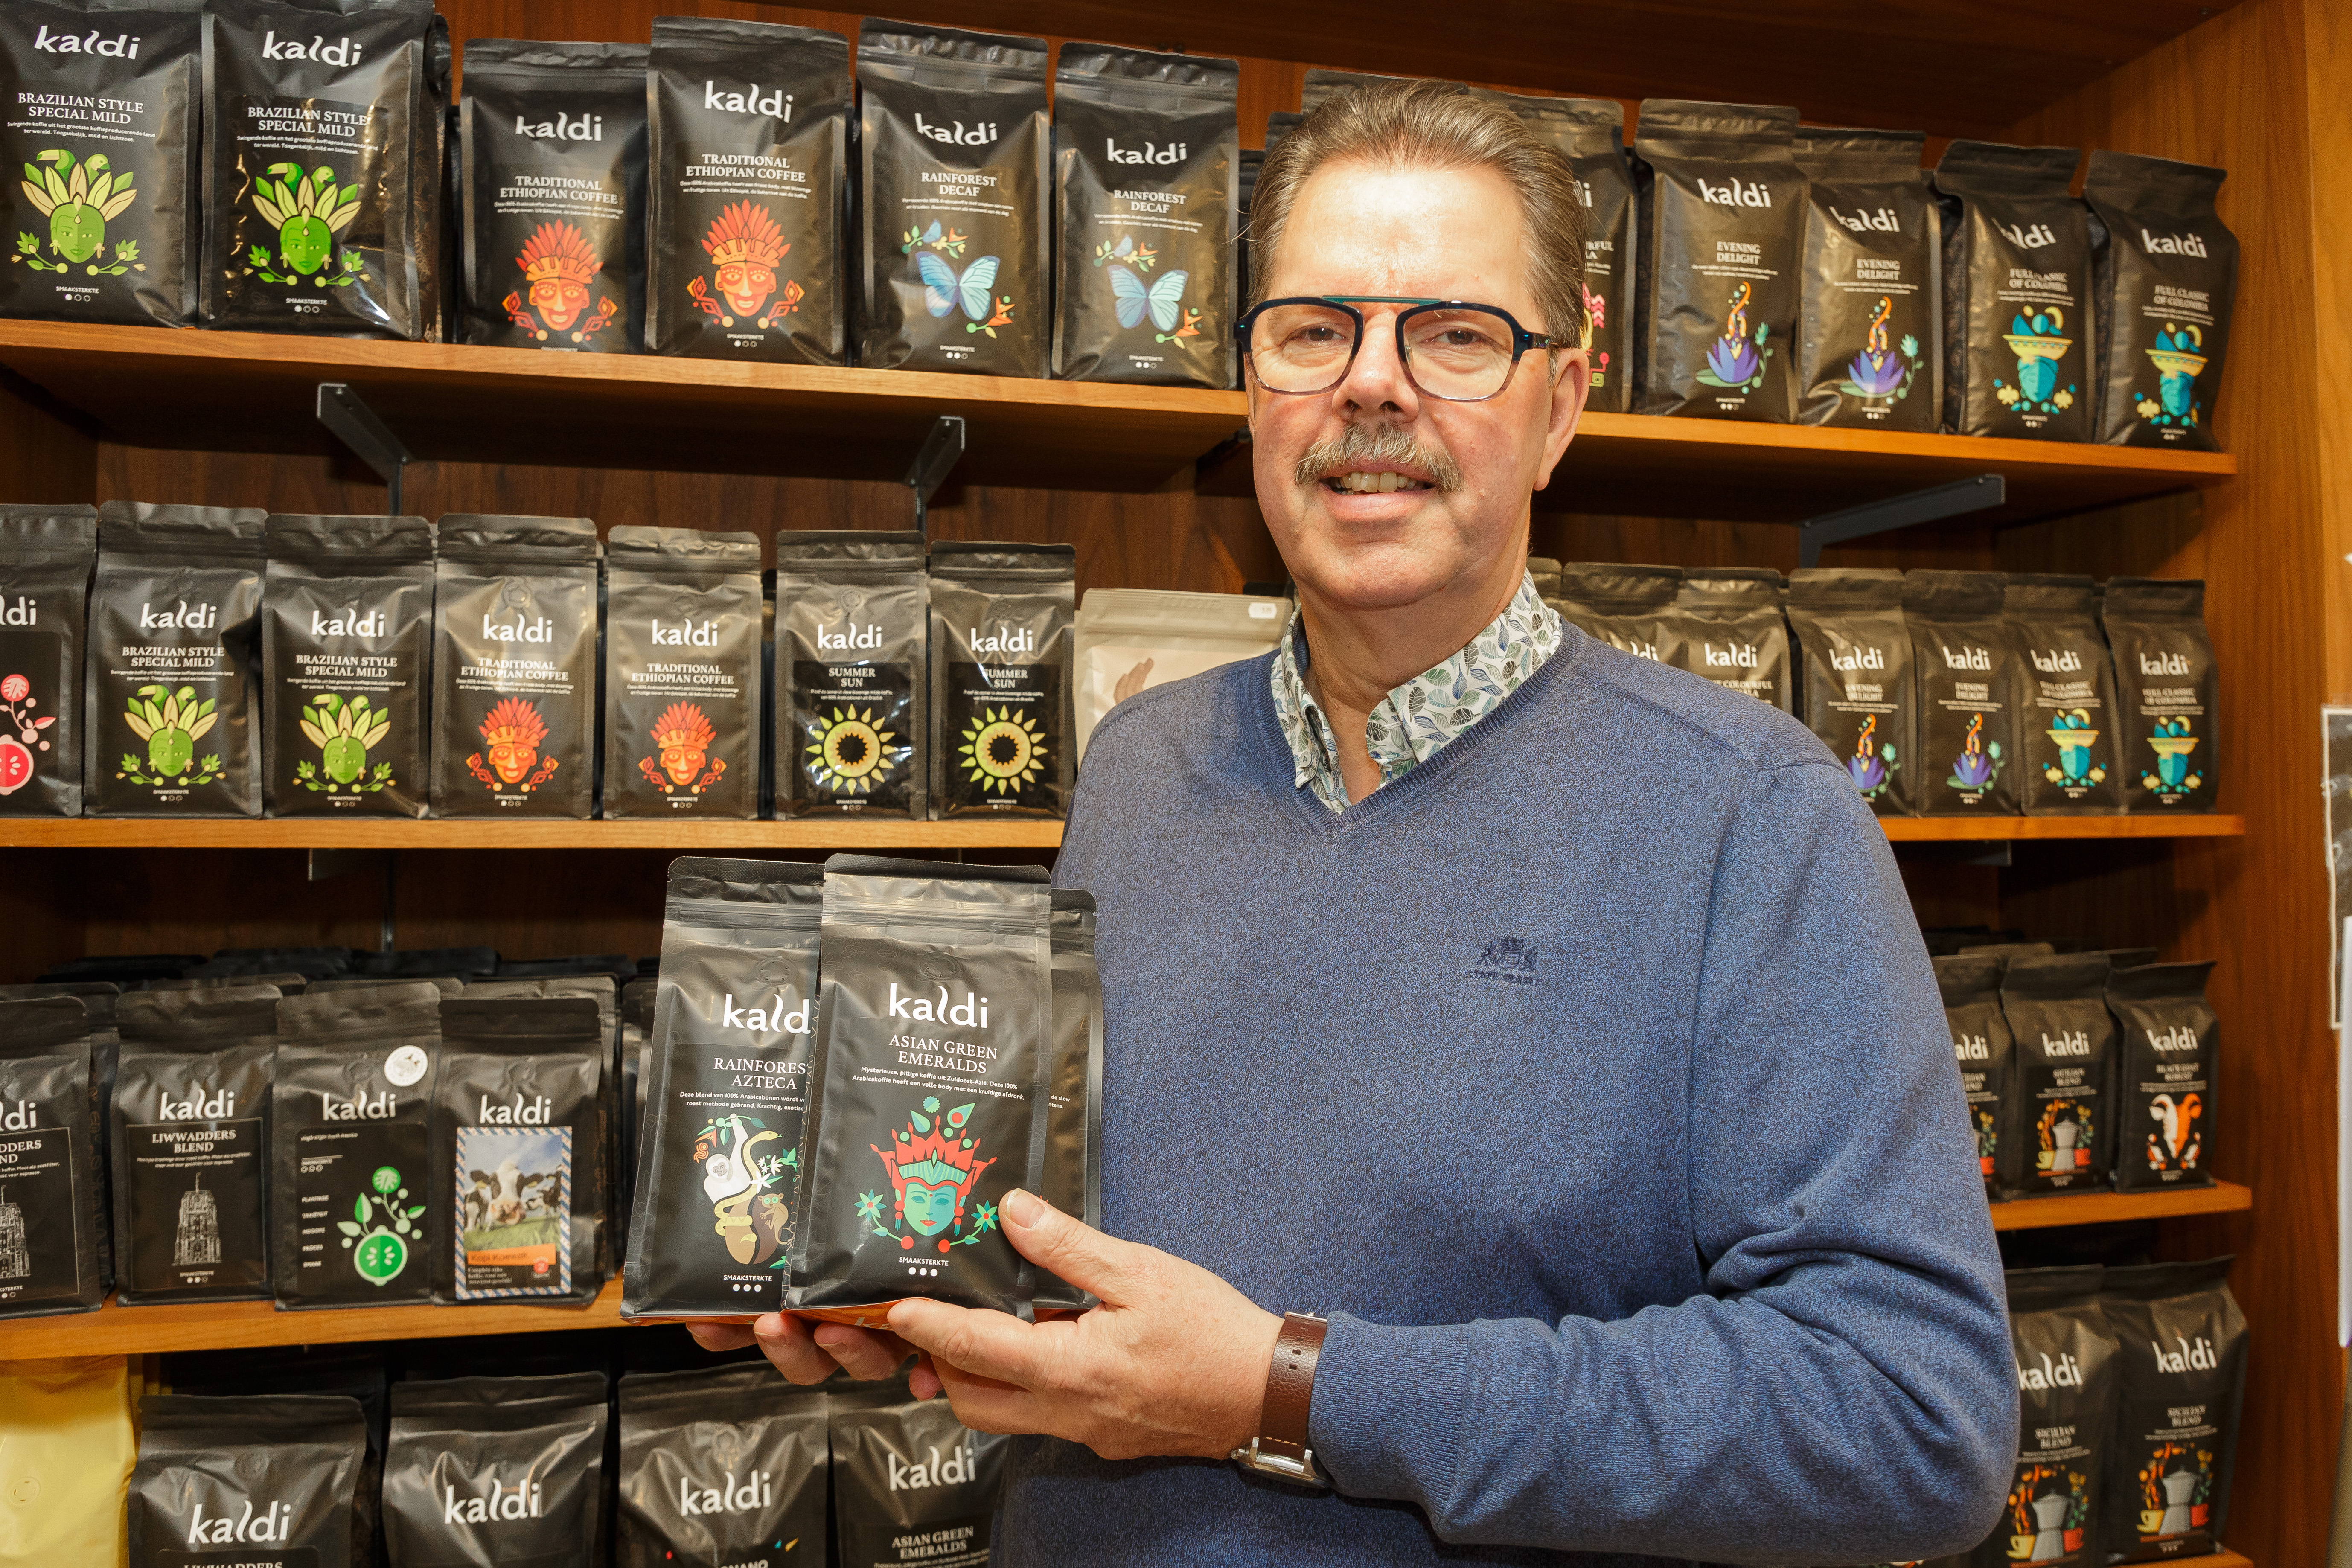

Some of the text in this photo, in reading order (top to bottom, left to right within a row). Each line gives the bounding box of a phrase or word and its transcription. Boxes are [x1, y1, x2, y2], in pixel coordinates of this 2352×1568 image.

[34, 25, 140, 60] kaldi
[262, 31, 362, 67] kaldi
[18, 93, 144, 113] BRAZILIAN STYLE
[705, 80, 794, 123] kaldi
[28, 107, 131, 124] SPECIAL MILD
[247, 107, 367, 126] BRAZILIAN STYLE
[90, 126, 142, 136] koffieproducerende
[258, 120, 356, 137] SPECIAL MILD
[515, 112, 602, 141] kaldi
[914, 113, 997, 145] kaldi
[702, 154, 790, 169] TRADITIONAL
[1107, 138, 1187, 165] kaldi
[515, 176, 603, 191] TRADITIONAL
[686, 166, 806, 183] ETHIOPIAN COFFEE
[921, 172, 997, 187] RAINFOREST
[500, 187, 618, 204] ETHIOPIAN COFFEE
[939, 184, 980, 196] DECAF
[1114, 190, 1187, 205] RAINFOREST
[1697, 177, 1772, 208] kaldi
[1131, 201, 1170, 213] DECAF
[1829, 206, 1900, 232] kaldi
[1717, 241, 1761, 254] EVENING
[2142, 229, 2207, 258] kaldi
[1717, 252, 1761, 265] DELIGHT
[1857, 268, 1900, 280] DELIGHT
[140, 600, 217, 628] kaldi
[311, 608, 385, 637] kaldi
[483, 613, 553, 643] kaldi
[652, 618, 718, 646] kaldi
[818, 622, 882, 649] kaldi
[971, 626, 1033, 652] kaldi
[122, 646, 225, 657] BRAZILIAN STYLE
[131, 657, 215, 667] SPECIAL MILD
[296, 654, 398, 667] BRAZILIAN STYLE
[1704, 643, 1758, 667] kaldi
[1829, 646, 1884, 671] kaldi
[1942, 646, 1991, 670] kaldi
[2030, 649, 2082, 672] kaldi
[305, 666, 388, 678] SPECIAL MILD
[461, 666, 569, 681] ETHIOPIAN COFFEE
[477, 657, 556, 670] TRADITIONAL
[647, 663, 722, 674] TRADITIONAL
[829, 667, 876, 677] SUMMER
[2140, 651, 2189, 675] kaldi
[632, 673, 734, 685] ETHIOPIAN COFFEE
[841, 678, 863, 687] SUN
[983, 669, 1028, 679] SUMMER
[994, 679, 1016, 688] SUN
[889, 982, 988, 1029] kaldi
[888, 1034, 998, 1060] ASIAN GREEN
[2042, 1030, 2090, 1057] kaldi
[2146, 1025, 2198, 1051] kaldi
[713, 1058, 809, 1074] RAINFORES
[898, 1050, 987, 1074] EMERALDS
[731, 1074, 797, 1090] AZTECA
[861, 1066, 898, 1076] Mysterieuze,
[920, 1072, 936, 1080] koffie
[947, 1075, 988, 1086] Zuidoost-Azië.
[852, 1075, 891, 1084] Arabicakoffie
[978, 1088, 1001, 1097] kruidige
[1002, 1092, 1025, 1100] afdronk.
[159, 1088, 235, 1121] kaldi
[323, 1090, 396, 1121] kaldi
[480, 1093, 552, 1125] kaldi
[757, 1103, 783, 1111] Krachtig,
[152, 1130, 236, 1143] LIWWADDERS
[174, 1142, 214, 1154] BLEND
[899, 1257, 949, 1267] SMAAKSTERKTE
[2152, 1337, 2217, 1373] kaldi
[2015, 1352, 2083, 1391] kaldi
[888, 1445, 976, 1491] kaldi
[445, 1478, 539, 1524] kaldi
[681, 1469, 771, 1516] kaldi
[188, 1500, 291, 1544] kaldi
[892, 1526, 974, 1548] ASIAN GREEN
[900, 1539, 967, 1559] EMERALDS
